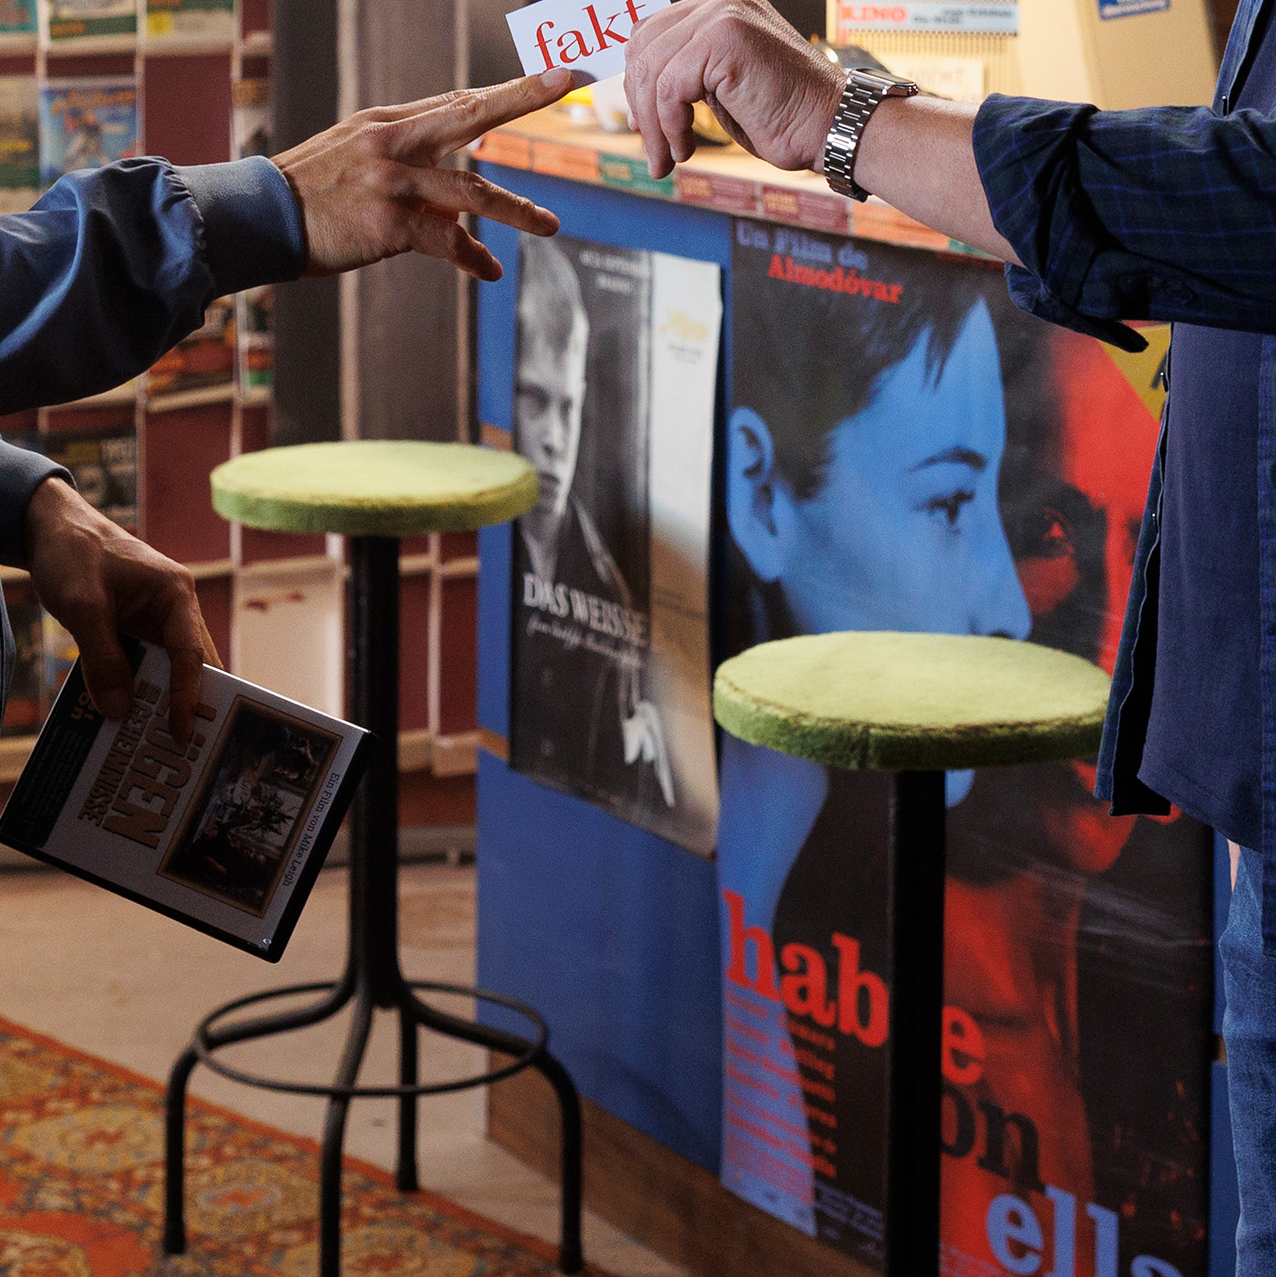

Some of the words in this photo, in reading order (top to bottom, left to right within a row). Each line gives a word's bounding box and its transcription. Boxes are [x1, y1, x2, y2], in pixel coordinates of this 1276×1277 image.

[767, 253, 904, 304] Almodóvar
[325, 772, 340, 795] Ein
[317, 795, 333, 816] Film
[309, 815, 321, 835] von
[296, 834, 314, 861] Mike
[281, 860, 300, 887] Leigh
